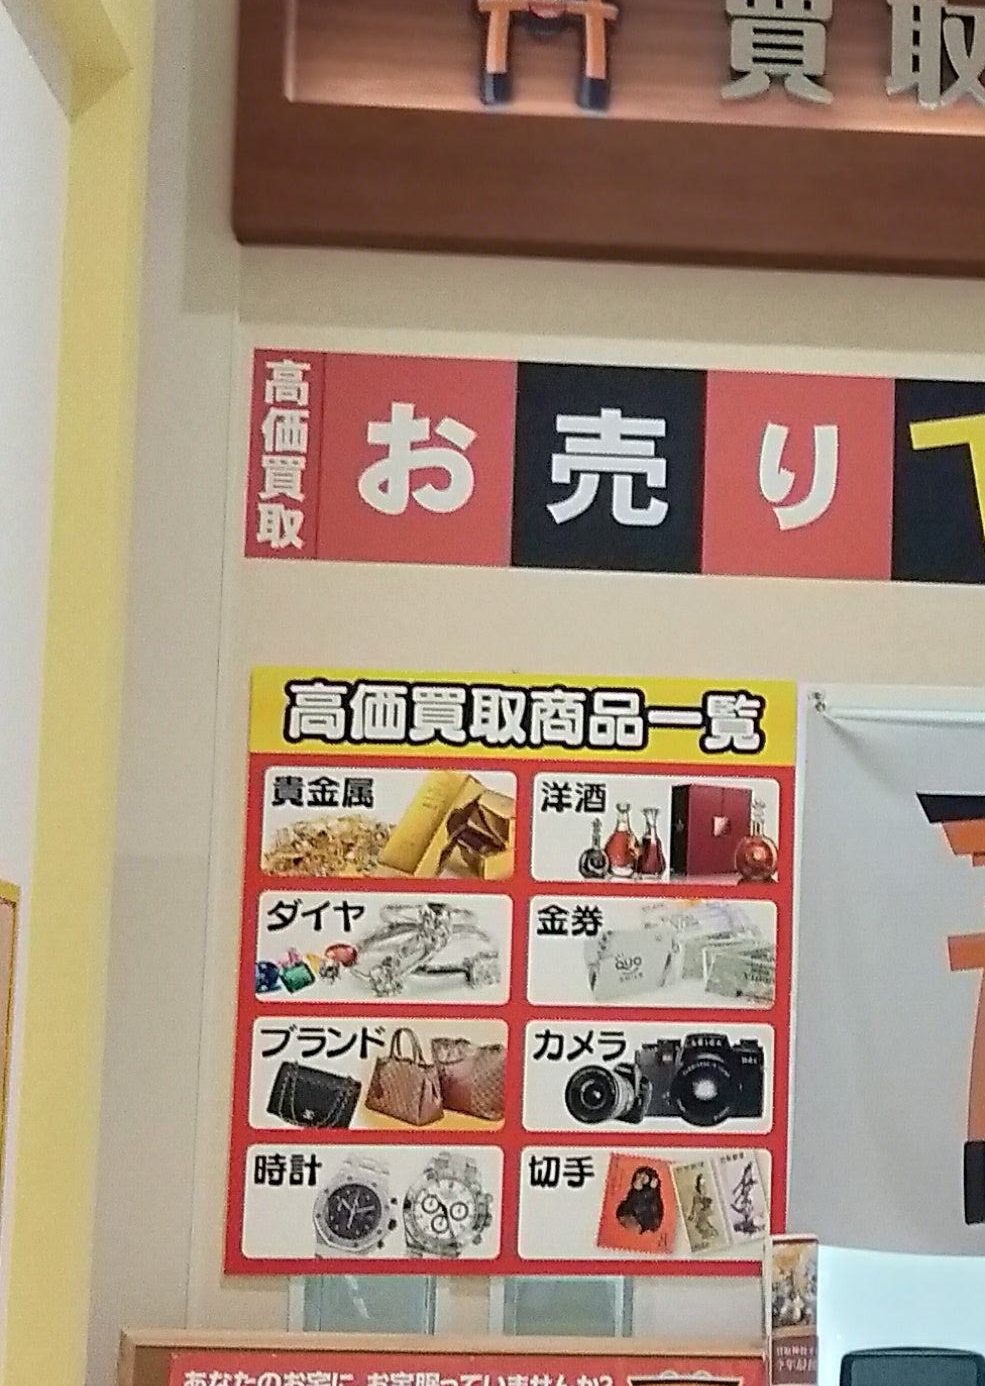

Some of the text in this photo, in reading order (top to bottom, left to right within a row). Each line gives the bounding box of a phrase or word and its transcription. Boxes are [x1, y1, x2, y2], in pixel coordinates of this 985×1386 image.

[256, 358, 311, 549] 高価買取
[285, 680, 766, 752] 高価買取商品一覧
[271, 776, 374, 808] 貴金属
[540, 781, 607, 813] 洋酒
[266, 900, 365, 932] ダイヤ
[536, 905, 604, 936] 金券
[260, 1025, 386, 1059] ブランド
[532, 1029, 628, 1060] カメラ
[254, 1154, 322, 1186] 時計
[529, 1155, 595, 1186] 切手
